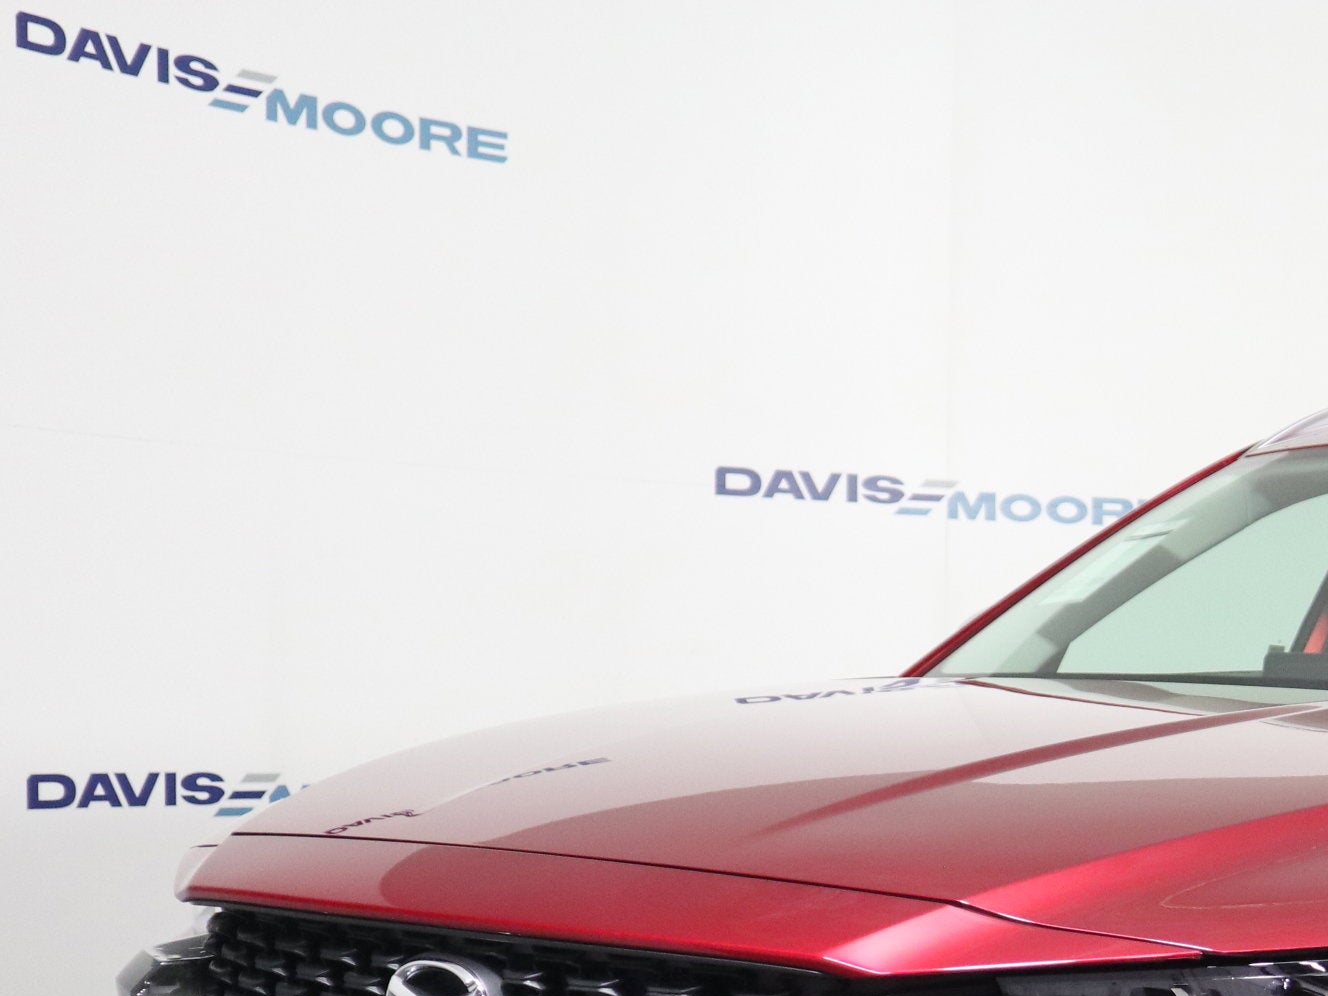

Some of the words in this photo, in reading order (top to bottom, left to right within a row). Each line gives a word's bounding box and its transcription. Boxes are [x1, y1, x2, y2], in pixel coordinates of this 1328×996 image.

[16, 11, 220, 92] DAVIS
[265, 88, 508, 164] MOORE
[714, 466, 905, 504] DAVIS
[947, 490, 1146, 526] MOOR
[26, 772, 225, 810] DAVIS
